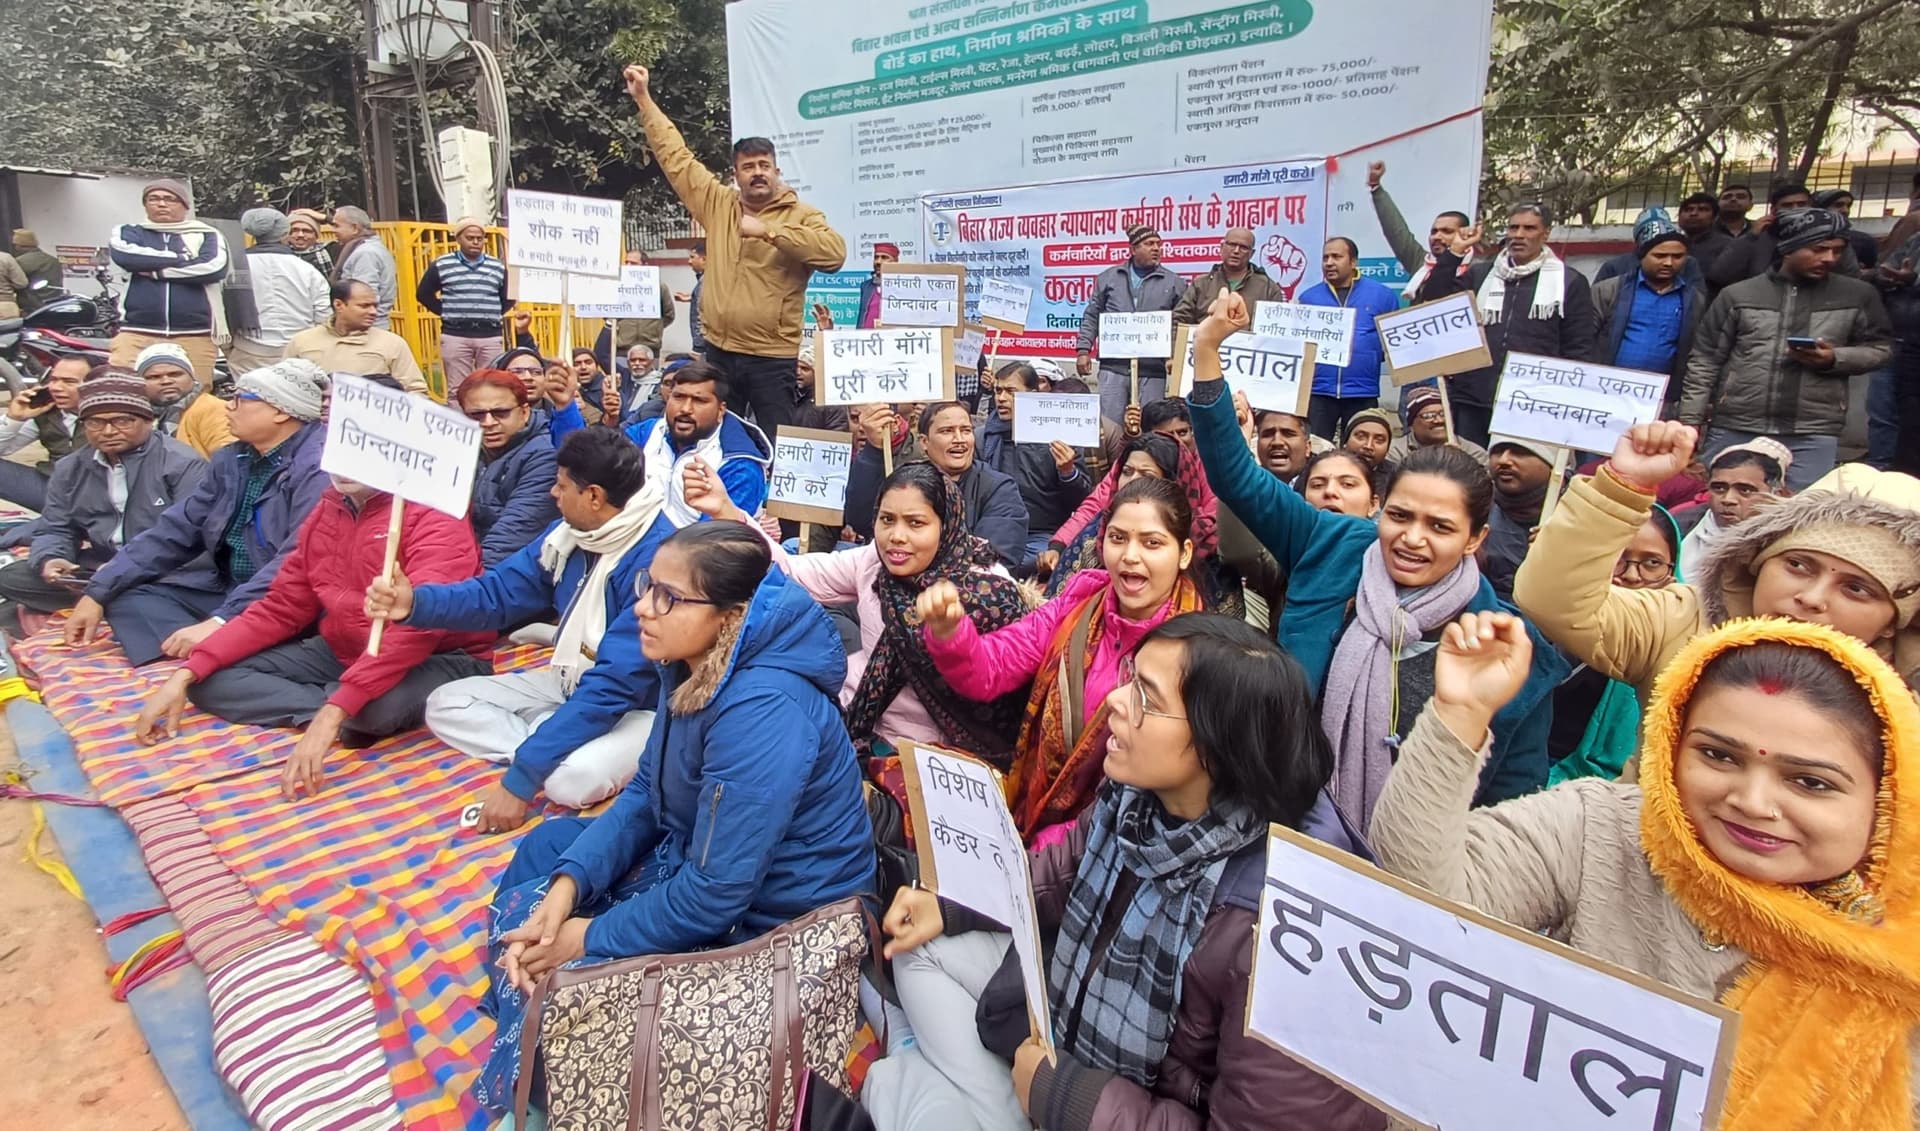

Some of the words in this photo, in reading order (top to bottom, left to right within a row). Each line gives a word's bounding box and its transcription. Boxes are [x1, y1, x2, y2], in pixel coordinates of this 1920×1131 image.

[882, 51, 905, 70] बोर्ड
[908, 51, 927, 65] का
[930, 44, 962, 62] हाथ,
[965, 32, 1012, 54] निर्माण
[1015, 17, 1071, 43] श्रमिकों
[1075, 13, 1094, 31] के
[1097, 6, 1138, 26] साथ
[914, 22, 930, 40] एवं
[933, 18, 961, 36] अन्य
[1223, 171, 1250, 186] हमारी
[1272, 167, 1289, 184] पूरी
[528, 217, 563, 241] शौक
[572, 226, 600, 246] नहीं
[958, 212, 987, 243] बिहार
[988, 216, 1015, 241] राज्य
[1017, 212, 1058, 240] व्यवहार
[1060, 208, 1118, 238] न्यायालय
[1178, 194, 1201, 231] संघ
[1206, 192, 1223, 229] के
[1285, 194, 1308, 226] पर
[1049, 246, 1107, 263] कर्मचारियों
[1361, 261, 1388, 277] कते
[927, 279, 956, 291] एकता
[1317, 309, 1344, 324] चतुर्थ
[1382, 306, 1472, 347] हड़ताल
[831, 333, 884, 357] हमारी
[1291, 326, 1344, 342] कर्मचारियों
[832, 370, 866, 400] पूरी
[876, 367, 909, 393] करें
[1509, 360, 1586, 388] कर्मचारी
[1598, 375, 1659, 400] एकता
[337, 380, 413, 423] कर्मचारी
[424, 408, 481, 446] एकता
[1508, 389, 1613, 428] जिन्दाबाद
[340, 417, 438, 477] जिन्दाबाद
[777, 441, 815, 463] हमारी
[773, 471, 797, 497] पूरी
[804, 475, 829, 497] करें
[928, 756, 989, 808] विशेष
[931, 814, 981, 860] कैडर
[1266, 877, 1704, 1131] हड़ताल
